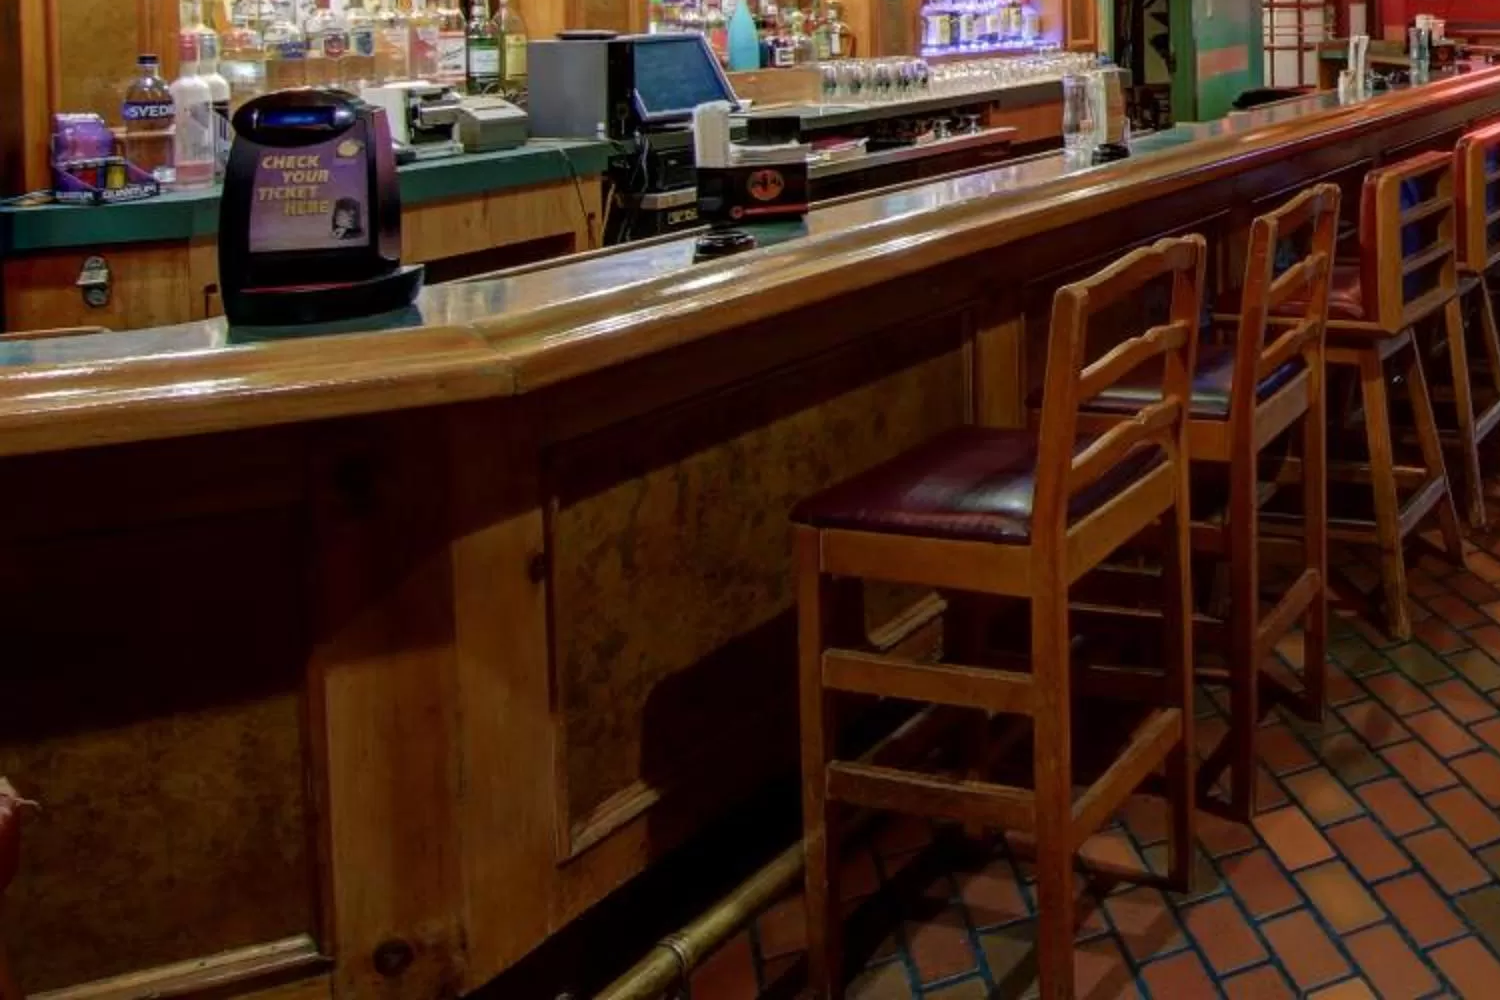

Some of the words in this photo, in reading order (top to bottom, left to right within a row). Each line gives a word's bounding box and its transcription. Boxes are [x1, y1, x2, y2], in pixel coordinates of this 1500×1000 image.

[128, 105, 174, 118] SVED
[261, 155, 321, 169] CHECK
[282, 169, 330, 183] YOUR
[258, 186, 319, 200] TICKET
